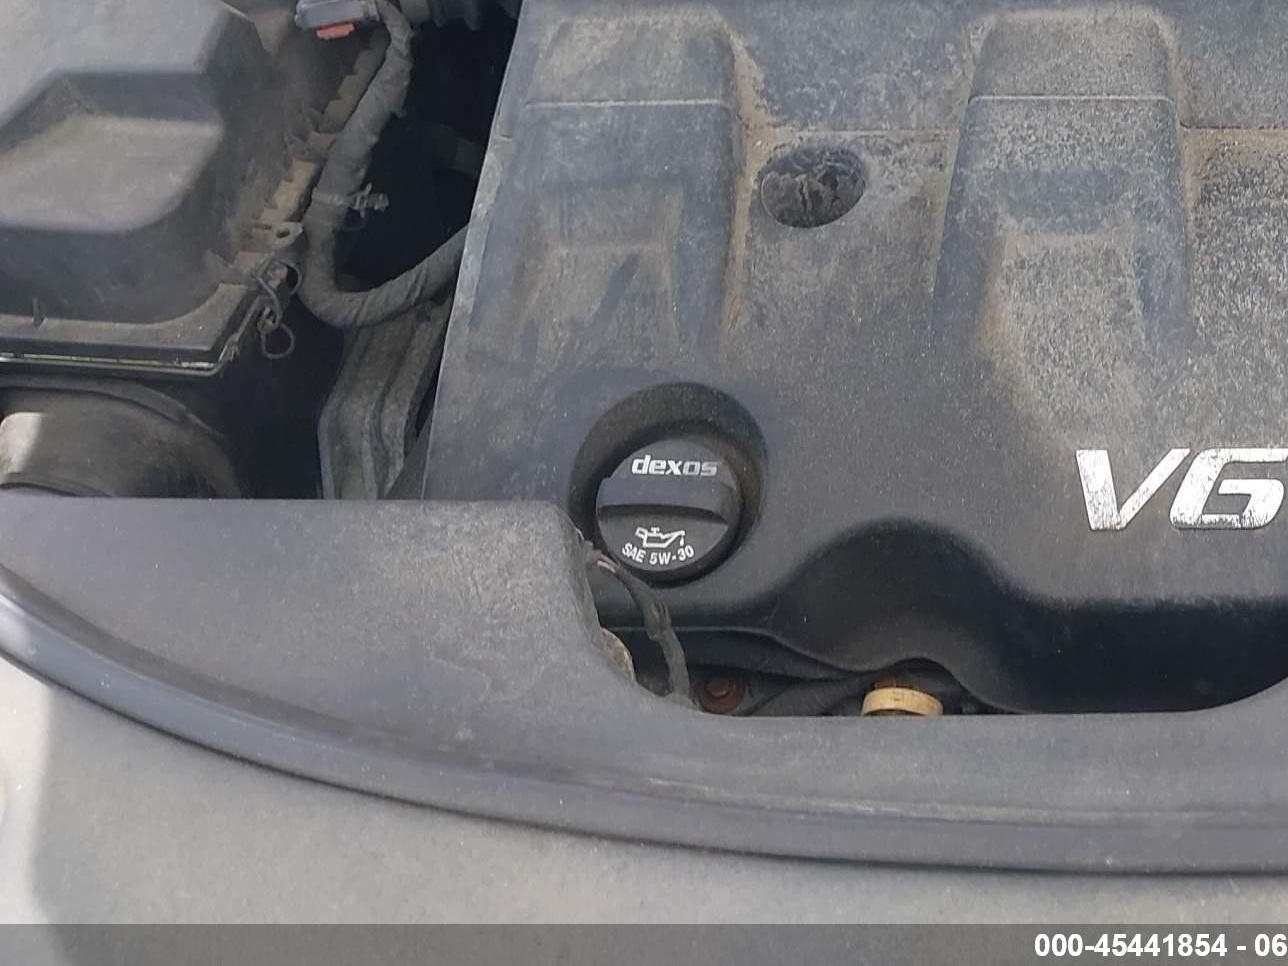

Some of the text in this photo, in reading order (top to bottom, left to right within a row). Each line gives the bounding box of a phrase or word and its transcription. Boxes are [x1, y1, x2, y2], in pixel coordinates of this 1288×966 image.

[631, 455, 720, 476] dexos
[622, 542, 695, 565] SAE 5W-30
